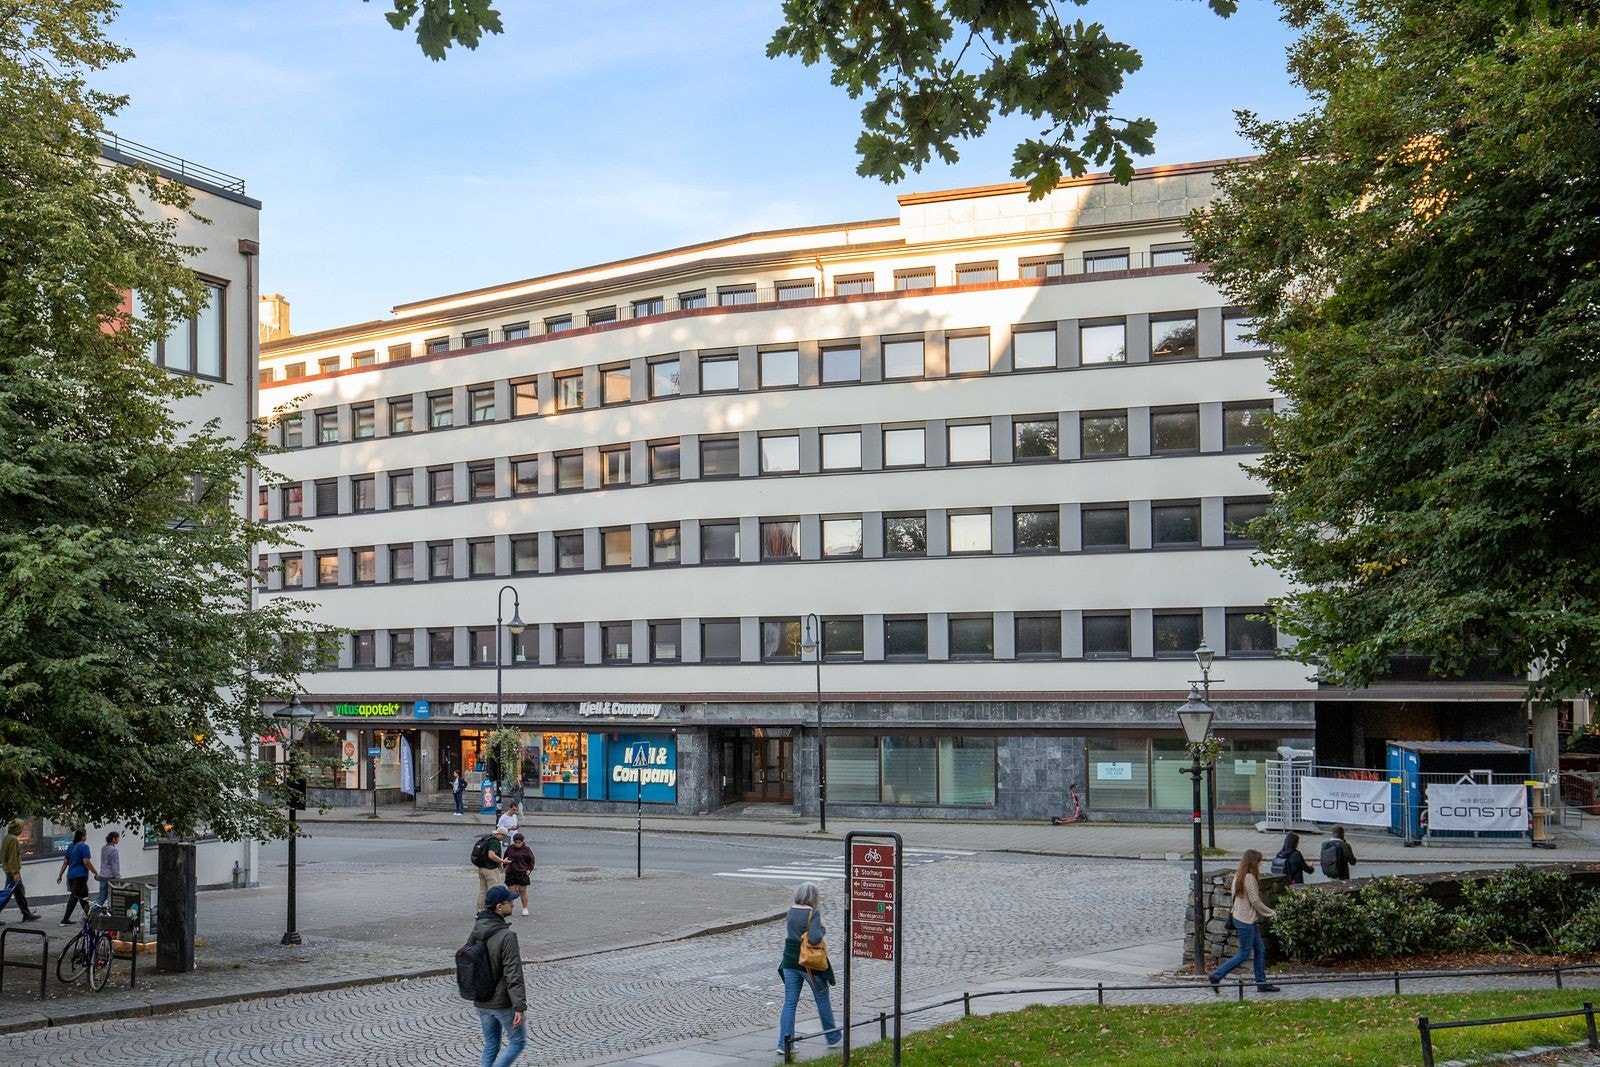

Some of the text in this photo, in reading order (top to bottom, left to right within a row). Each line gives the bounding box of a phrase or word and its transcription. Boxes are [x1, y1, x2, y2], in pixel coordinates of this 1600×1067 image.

[453, 702, 475, 716] Kjell
[475, 702, 482, 714] &
[579, 702, 661, 717] Kjell & Company
[624, 747, 667, 764] Kll &
[613, 765, 676, 786] Company
[861, 868, 882, 877] Storhaug
